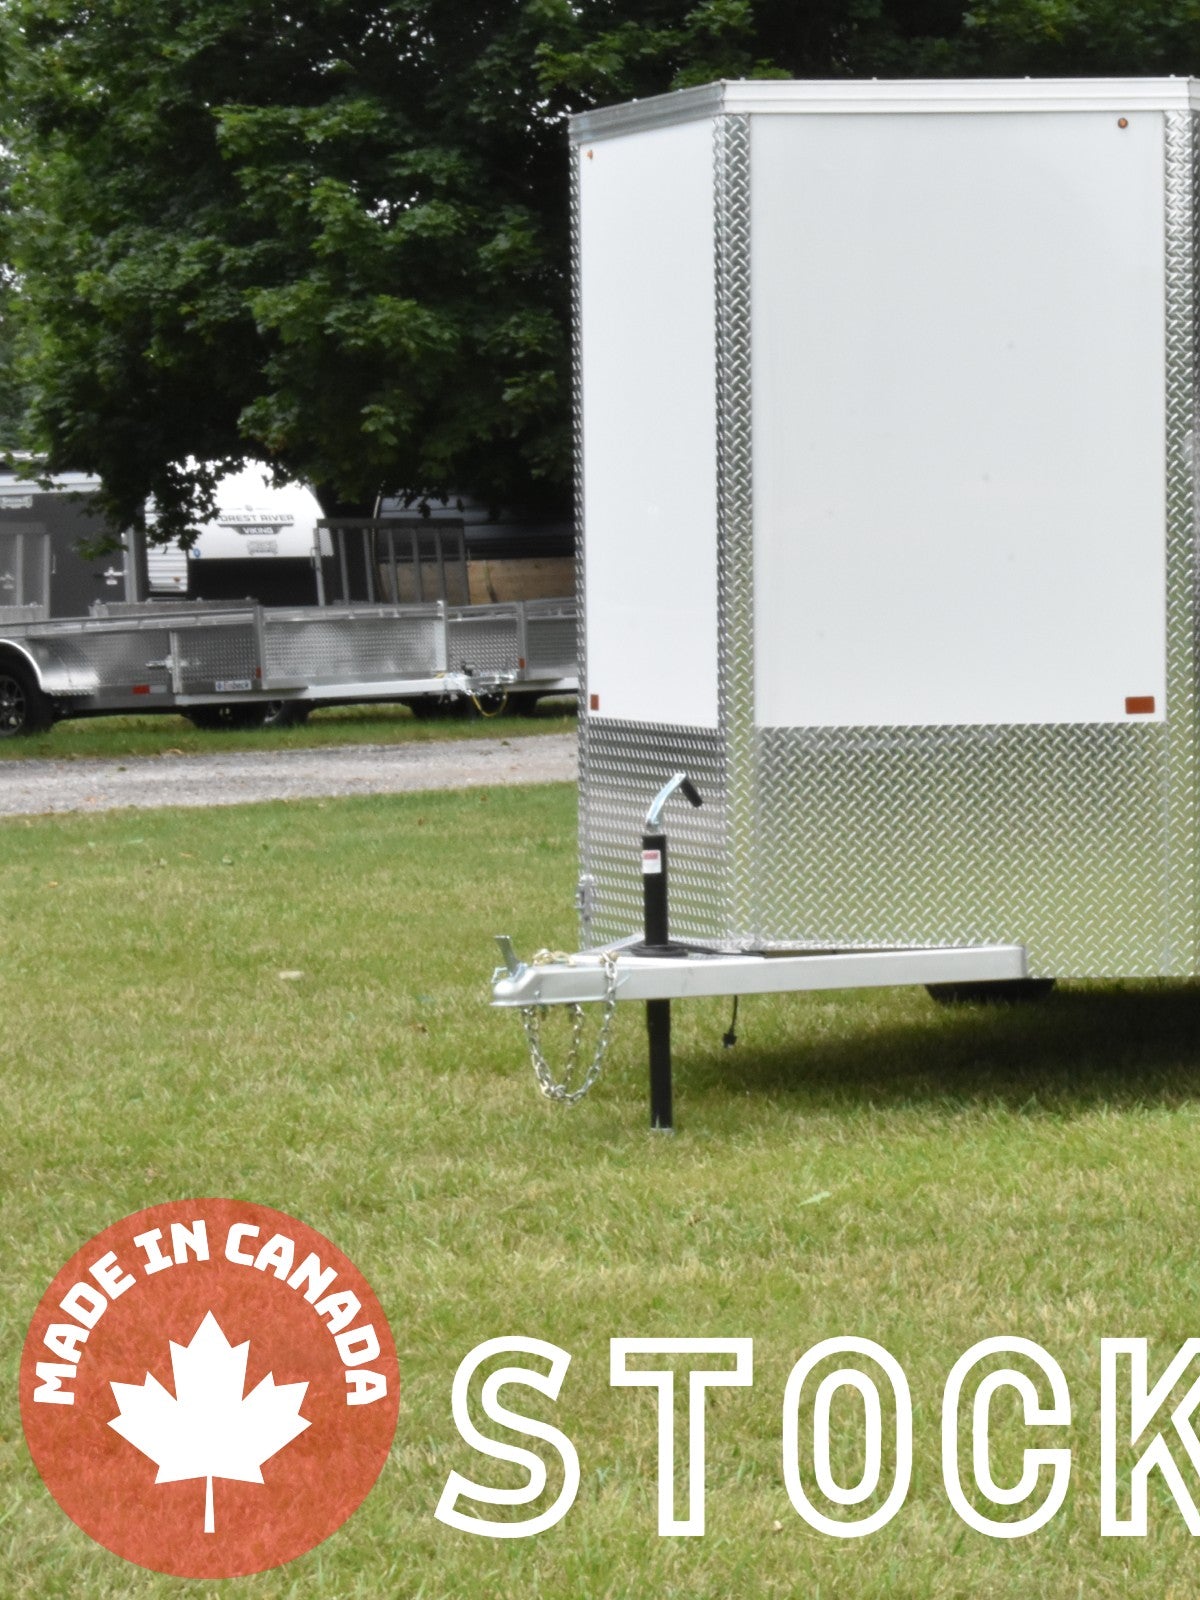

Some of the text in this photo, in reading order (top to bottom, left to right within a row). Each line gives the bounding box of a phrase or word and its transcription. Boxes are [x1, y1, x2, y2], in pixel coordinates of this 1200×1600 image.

[219, 514, 294, 522] OREST RIVER
[241, 526, 274, 535] VIKING
